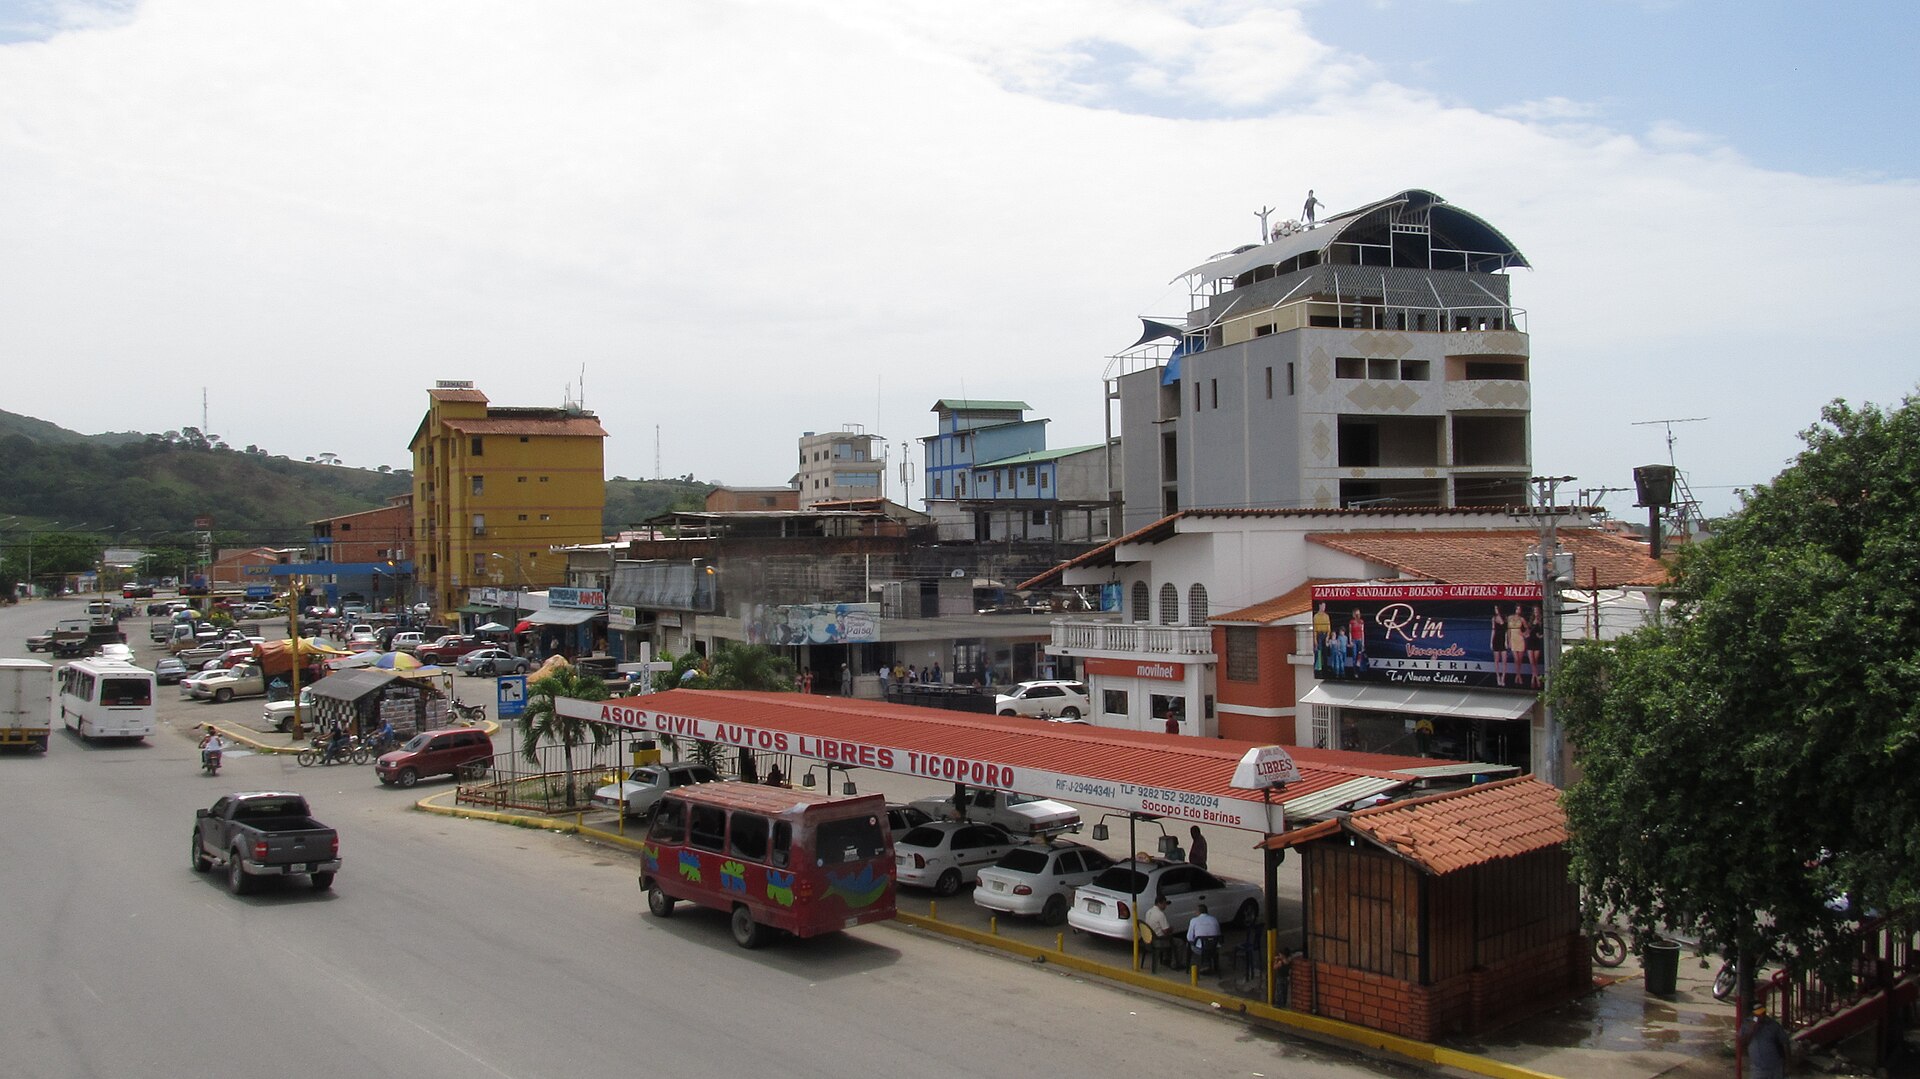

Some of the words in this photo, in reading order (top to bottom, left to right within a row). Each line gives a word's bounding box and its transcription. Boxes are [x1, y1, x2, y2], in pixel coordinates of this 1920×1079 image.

[1314, 588, 1351, 597] ZAPATOS
[1356, 587, 1403, 597] SANDALIAS
[1408, 587, 1444, 597] BOLSOS
[1450, 586, 1498, 597] CARTERAS
[1504, 586, 1542, 597] MALETA
[1375, 602, 1444, 642] Rim
[1136, 663, 1174, 678] movilnet
[1373, 660, 1482, 670] ZAPATERIA
[1386, 670, 1402, 681] Tu
[600, 705, 648, 727] ASOC
[655, 714, 705, 738] CIVIL
[715, 723, 788, 752] AUTOS
[800, 736, 894, 769] LIBRES
[908, 752, 1014, 788] TICOPORO
[1256, 758, 1293, 776] LIBRES
[1120, 784, 1136, 795] TLF
[1179, 792, 1220, 809] 9282094
[1183, 806, 1201, 819] Edo
[1203, 809, 1241, 825] Barinas
